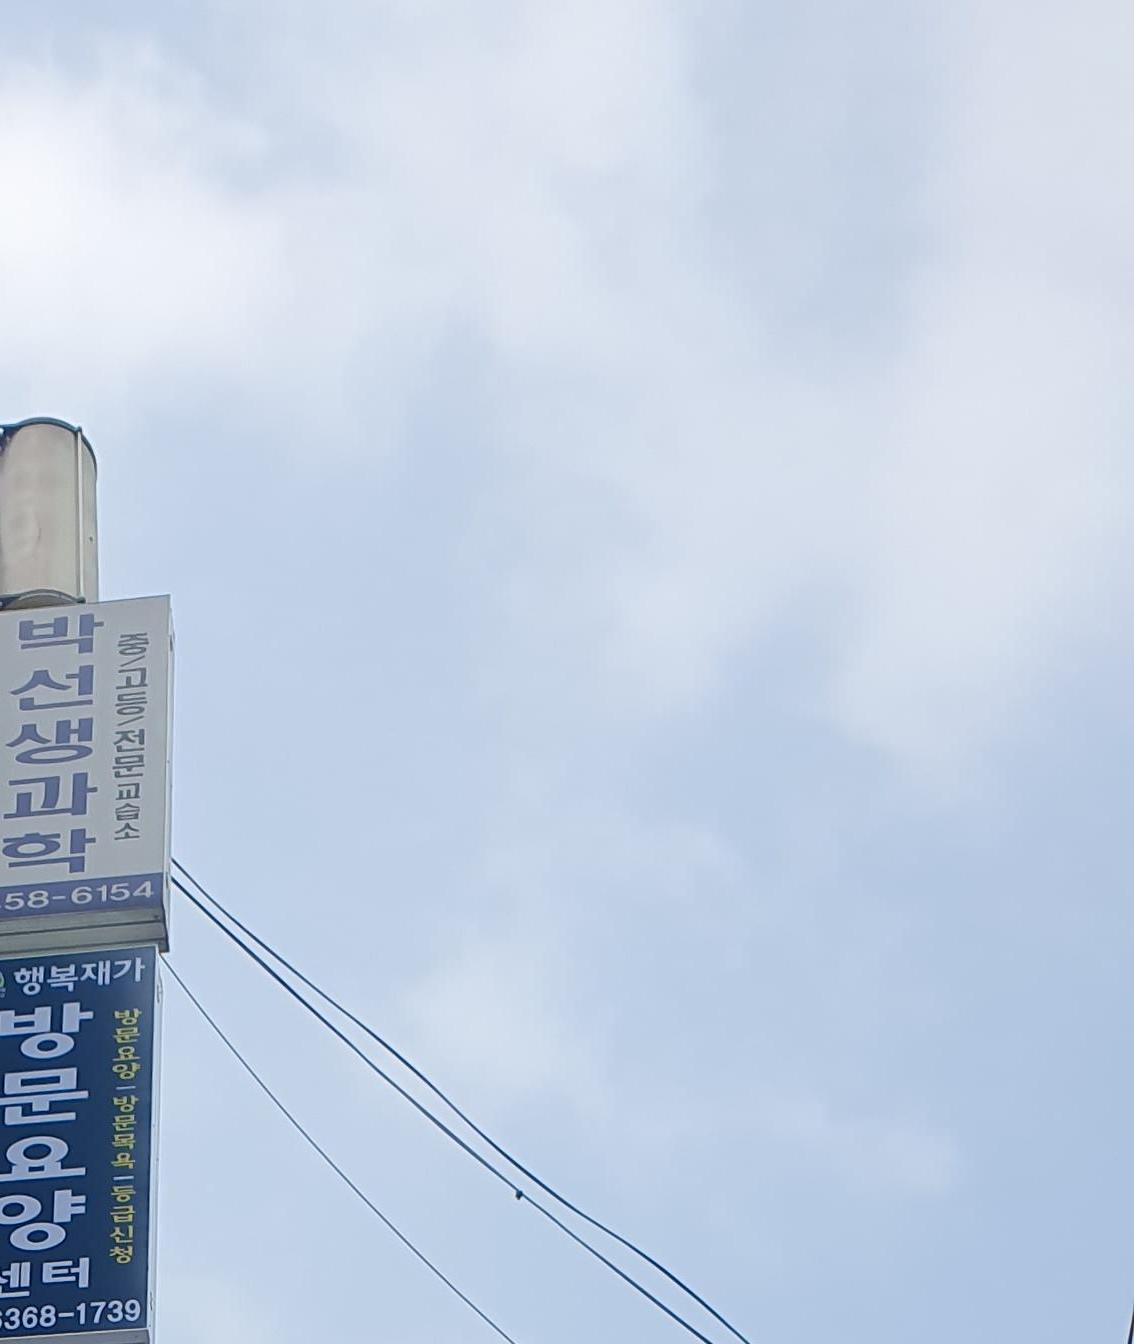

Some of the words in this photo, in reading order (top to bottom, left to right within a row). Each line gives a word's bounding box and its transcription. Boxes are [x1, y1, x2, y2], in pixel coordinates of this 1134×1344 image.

[2, 613, 105, 873] 박선생과학
[13, 957, 146, 996] 행복재가
[111, 1008, 142, 1080] 방문요양
[110, 1094, 139, 1169] 방문목욕
[109, 1185, 137, 1264] 등급신청
